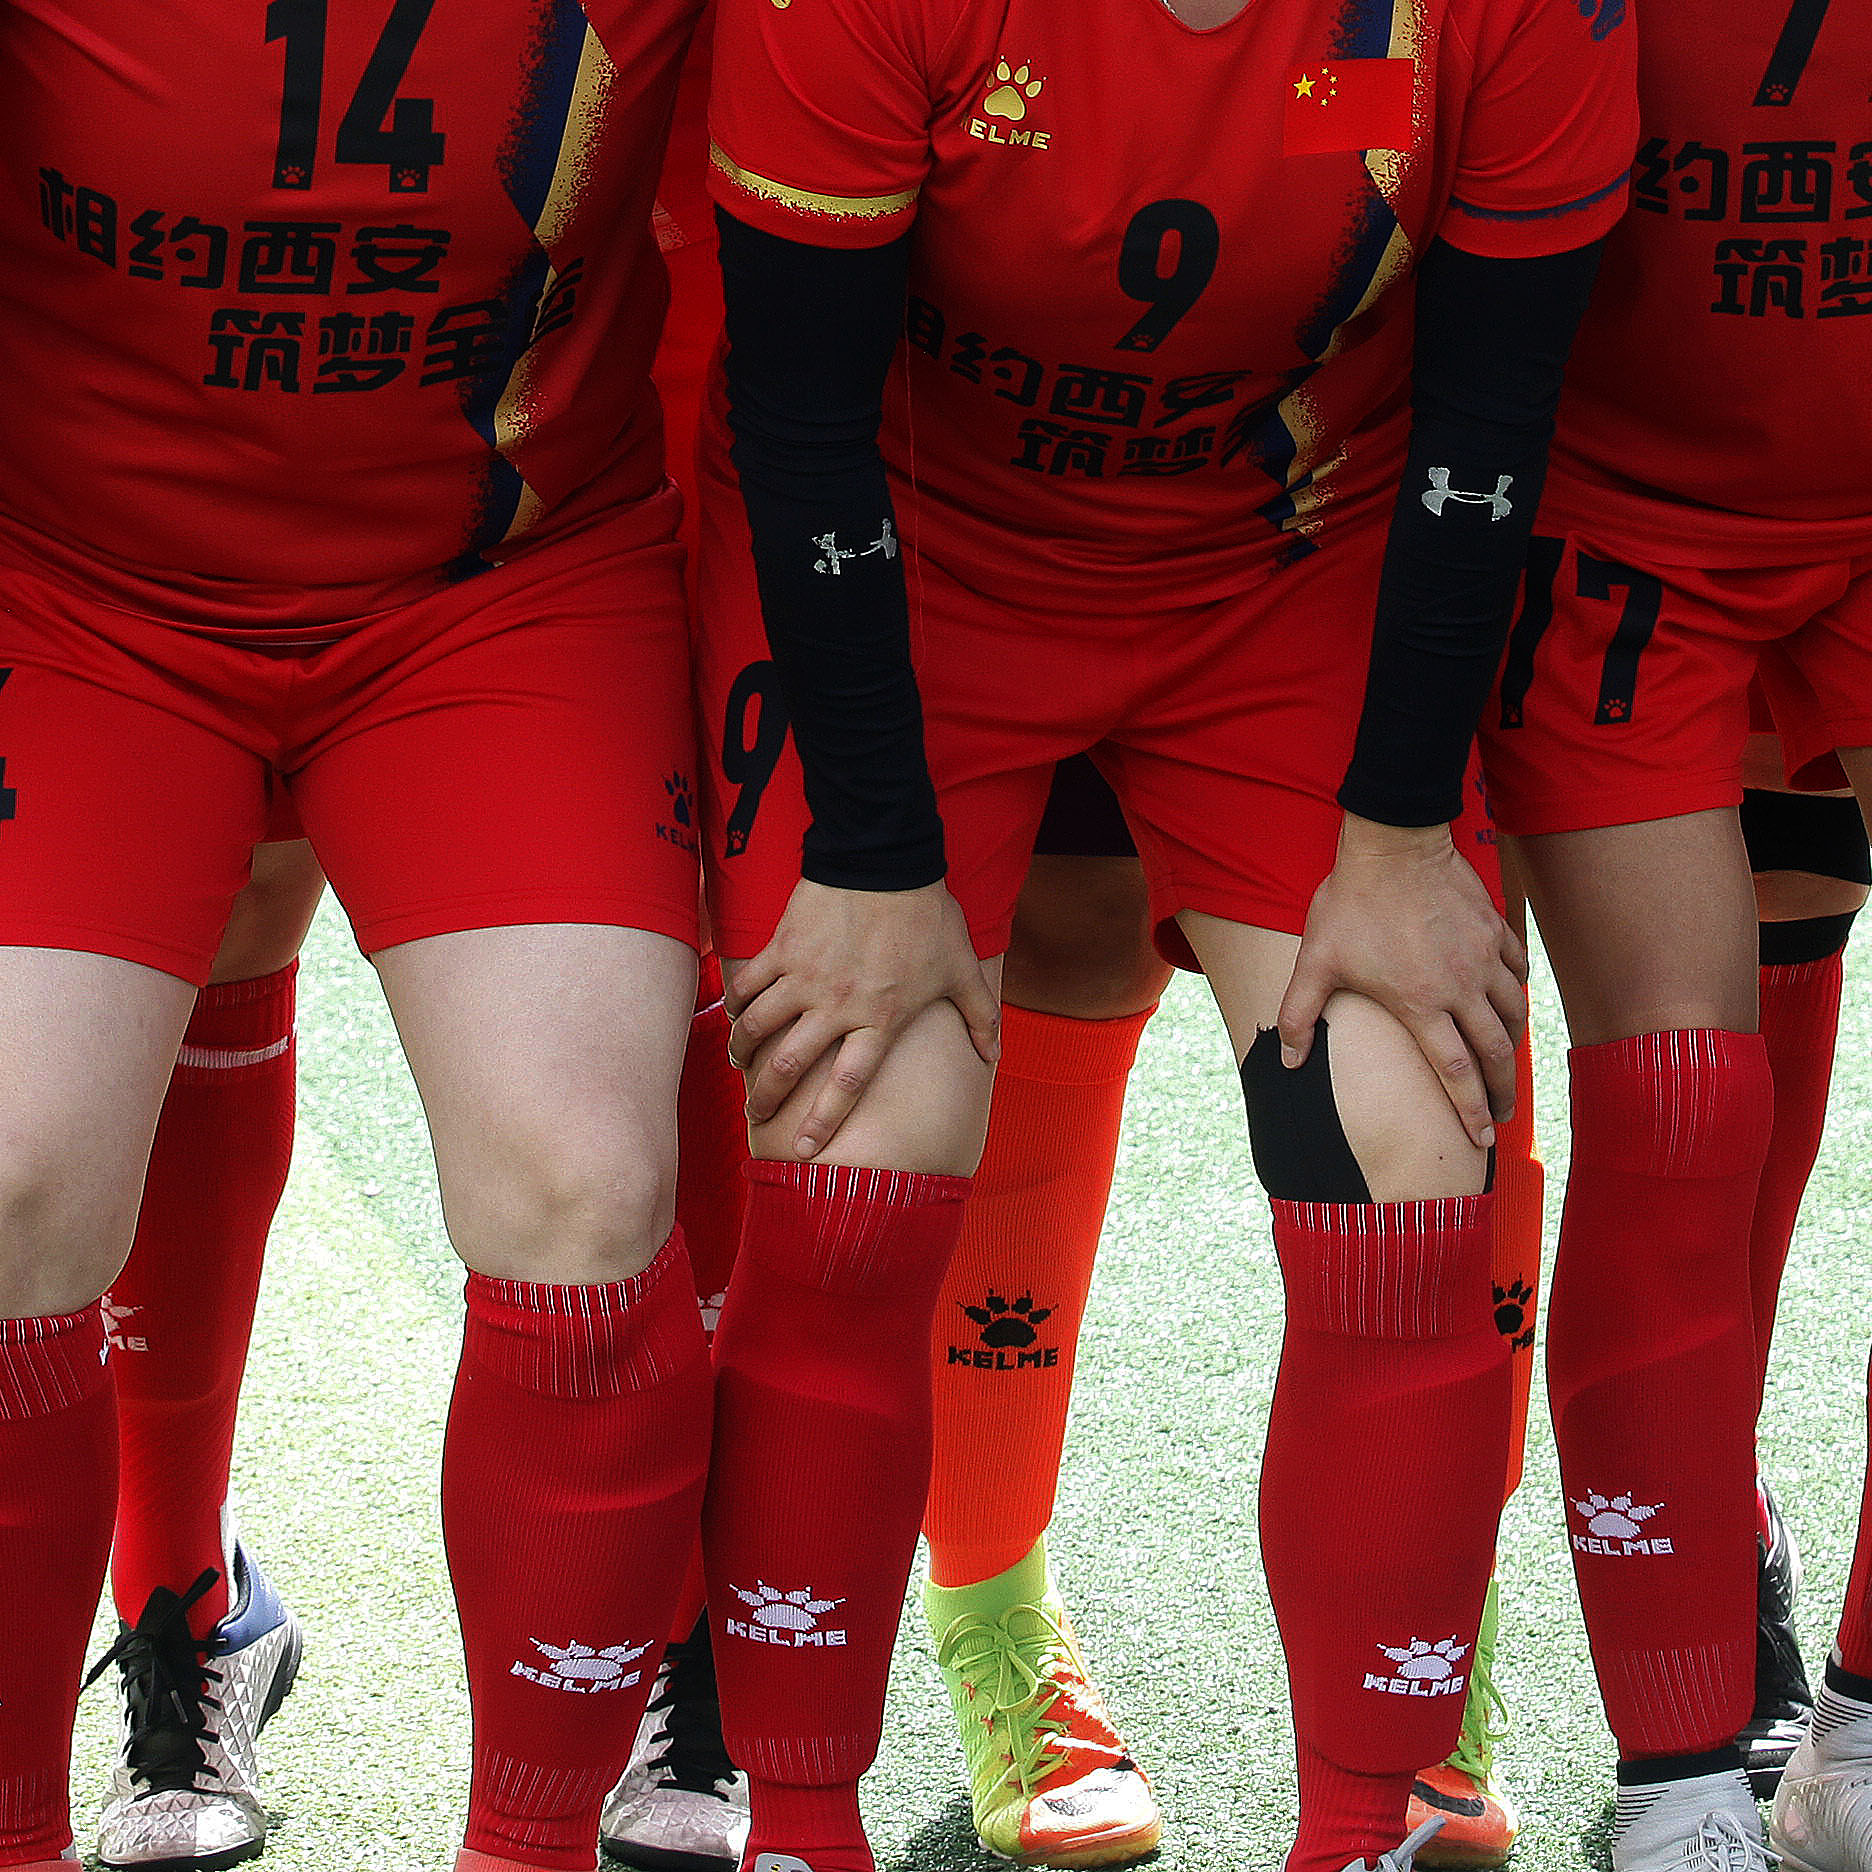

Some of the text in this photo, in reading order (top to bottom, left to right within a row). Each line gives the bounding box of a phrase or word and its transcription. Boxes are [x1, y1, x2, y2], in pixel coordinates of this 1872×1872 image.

[38, 166, 453, 298] 相约西安
[1117, 198, 1220, 354] 9
[720, 659, 793, 859] 9
[948, 1345, 1058, 1371] KELME
[1572, 1536, 1674, 1556] KELME
[728, 1618, 848, 1649] KELME
[509, 1661, 641, 1695] KELME
[1363, 1672, 1463, 1697] KELME
